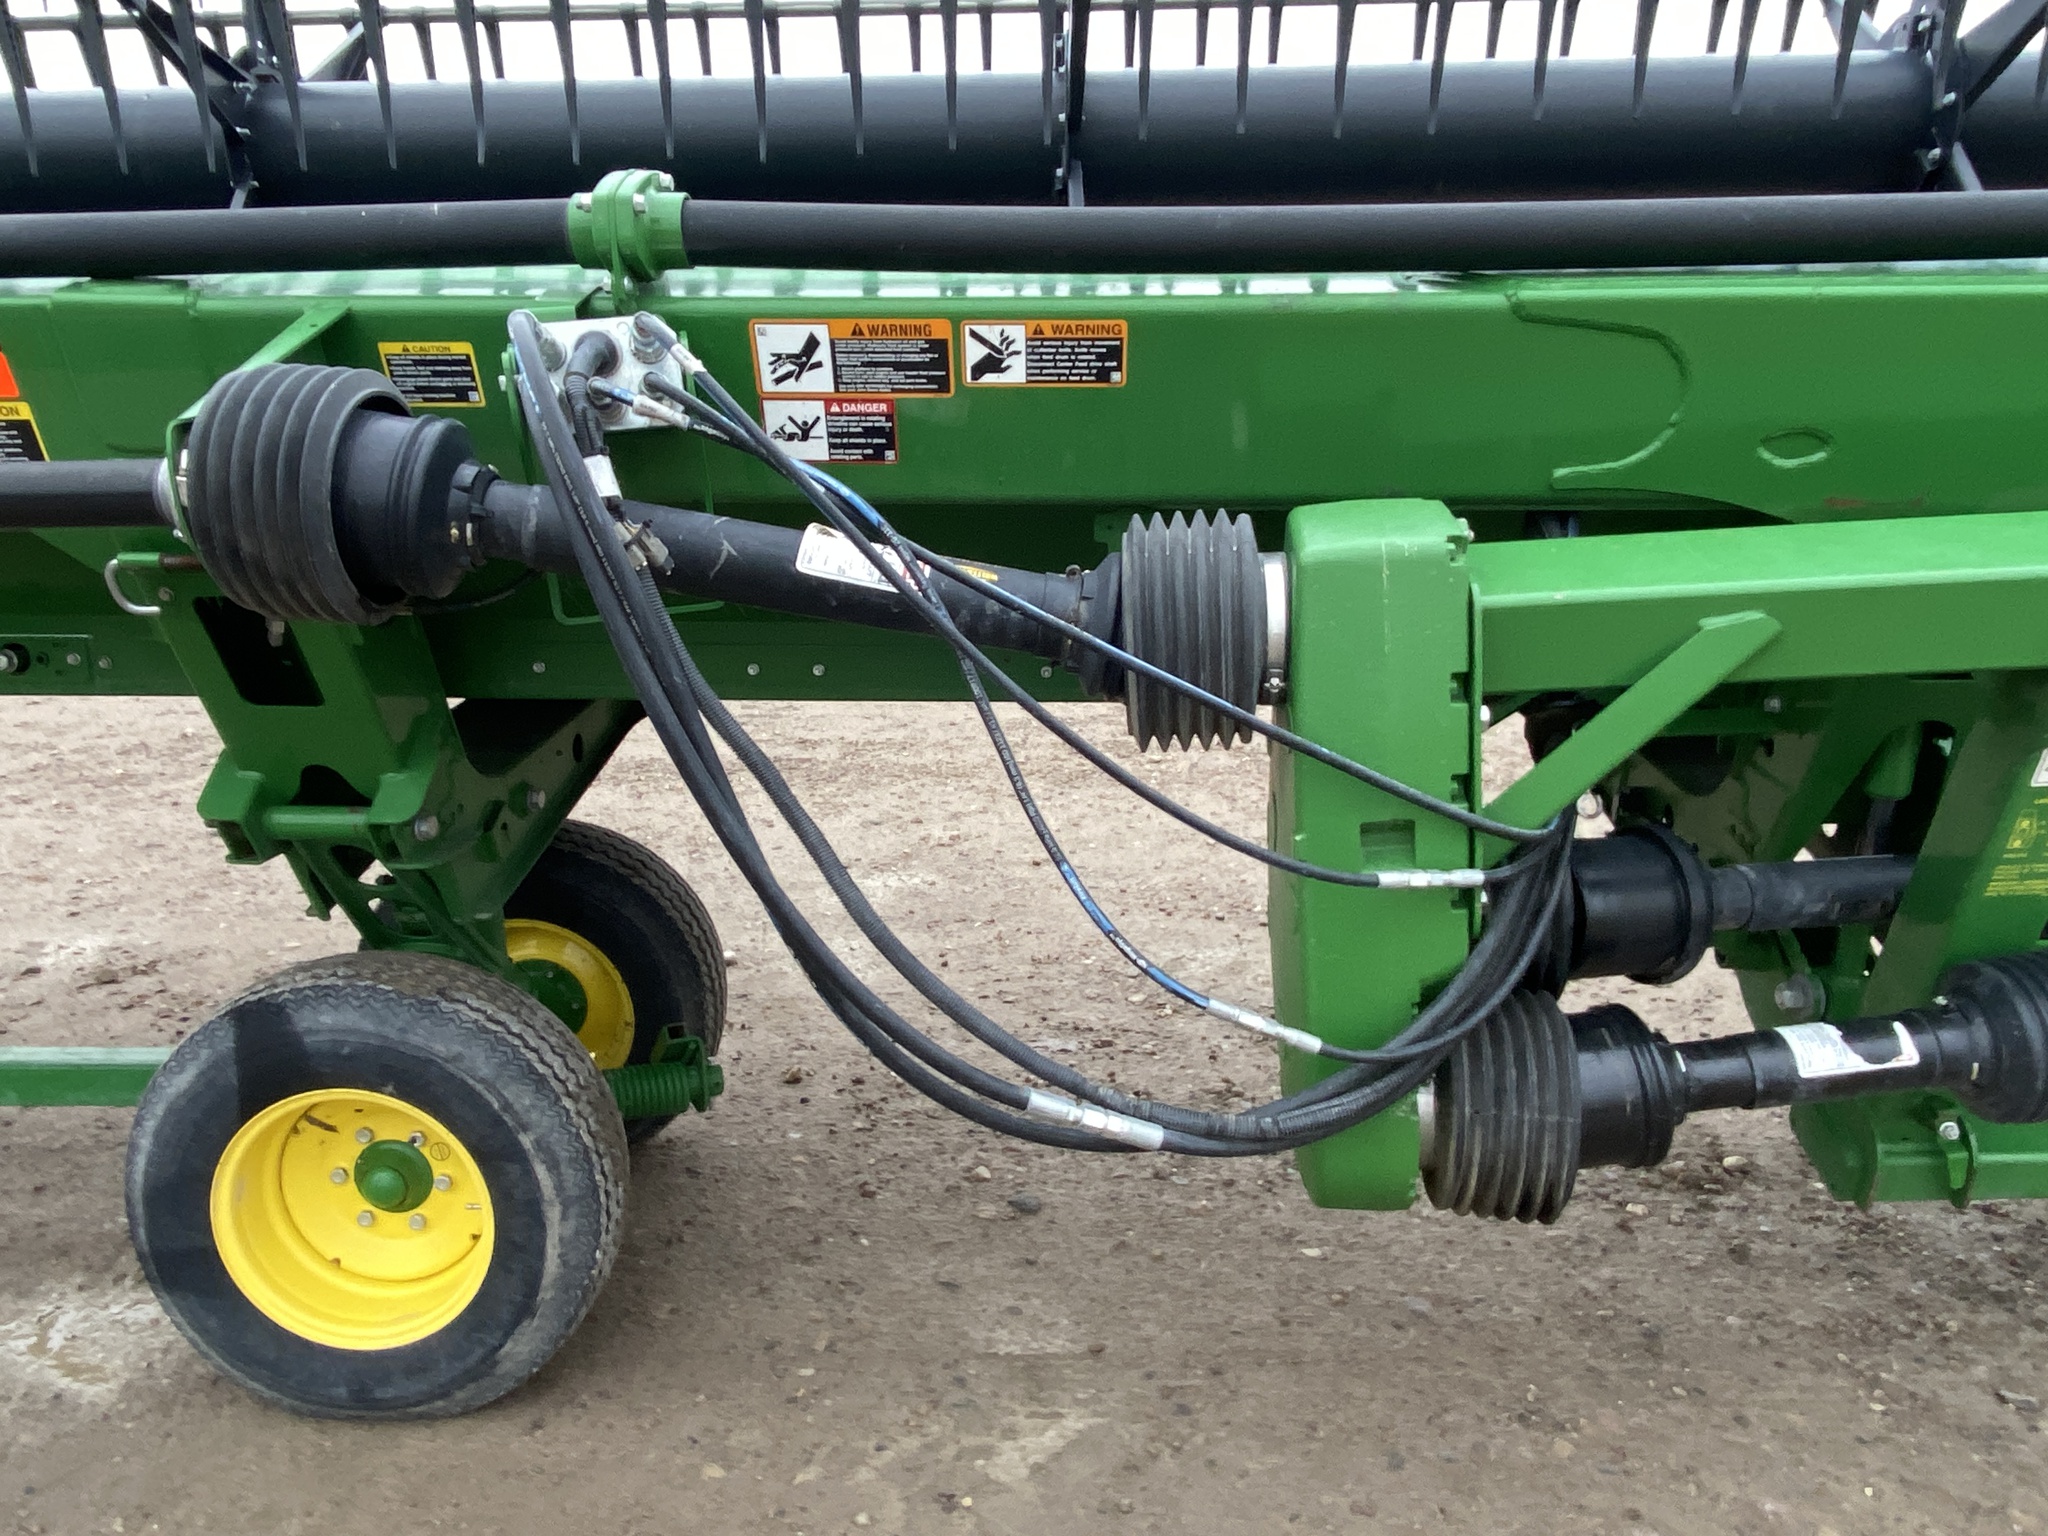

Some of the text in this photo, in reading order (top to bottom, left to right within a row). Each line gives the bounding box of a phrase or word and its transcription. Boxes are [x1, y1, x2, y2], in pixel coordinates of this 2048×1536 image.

[867, 324, 932, 337] WARNING
[1051, 324, 1122, 335] WARNING
[842, 403, 888, 412] DANGER
